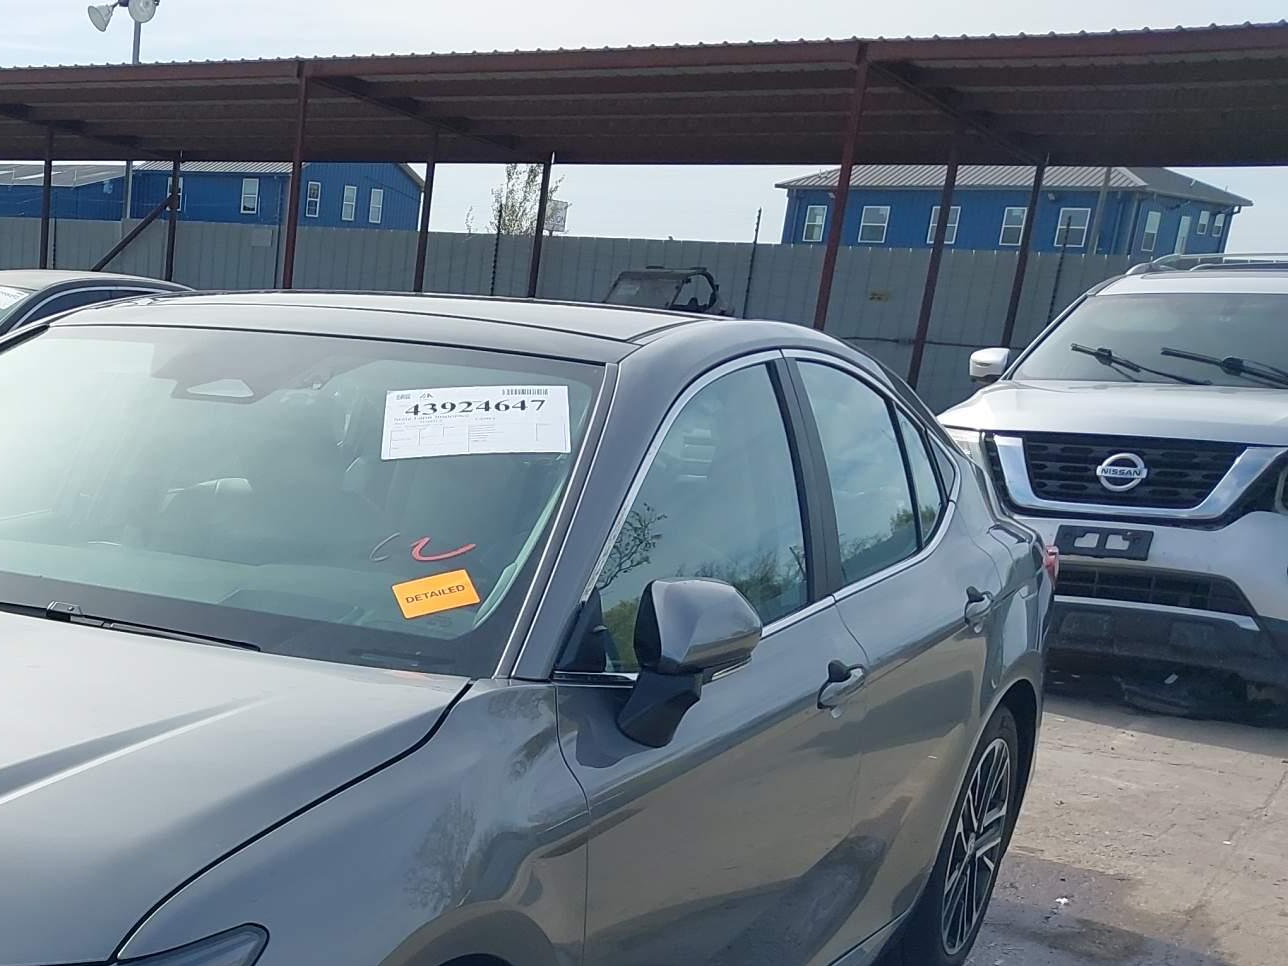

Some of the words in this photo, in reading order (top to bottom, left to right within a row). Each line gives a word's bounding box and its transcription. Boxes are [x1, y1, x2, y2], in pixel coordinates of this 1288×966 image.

[404, 400, 547, 416] 43924647
[1101, 468, 1142, 477] NISSAN
[405, 584, 466, 604] DETAILED
